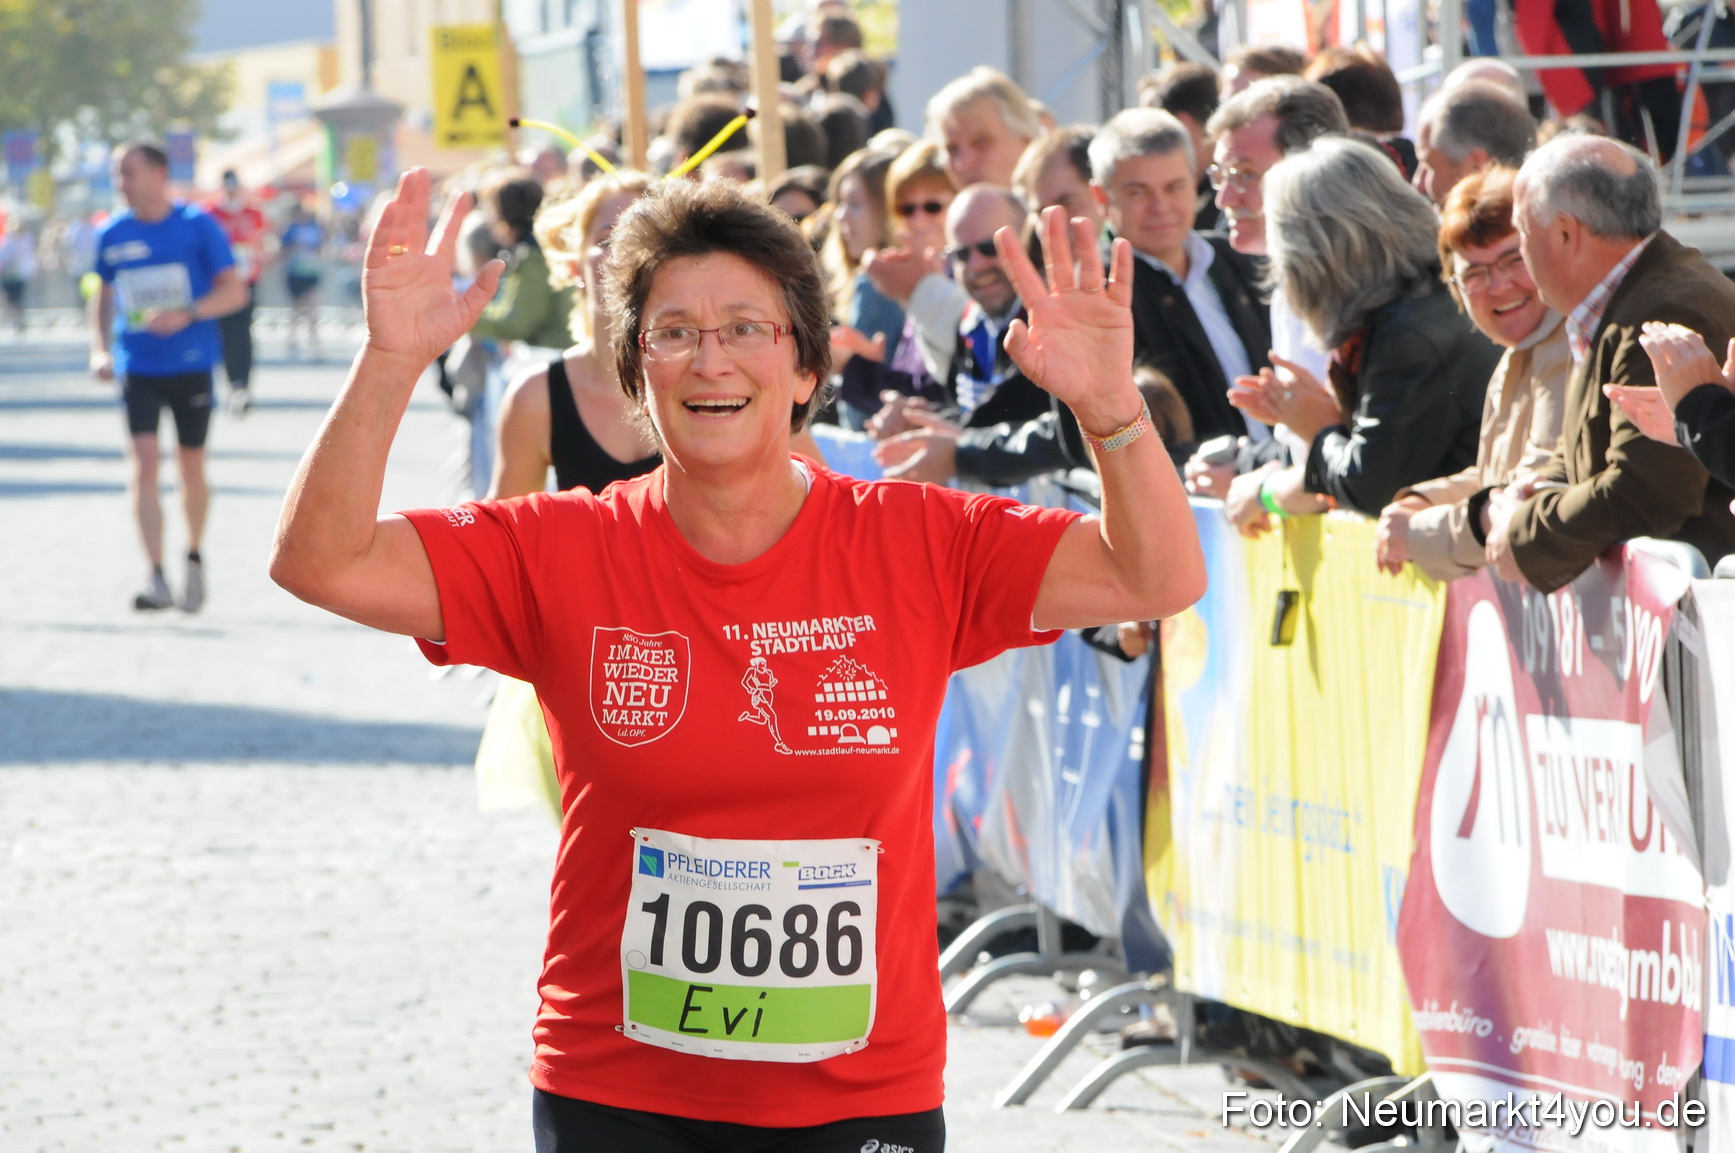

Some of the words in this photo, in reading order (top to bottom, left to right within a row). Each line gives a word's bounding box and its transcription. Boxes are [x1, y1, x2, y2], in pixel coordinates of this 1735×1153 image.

[453, 62, 495, 120] A
[722, 624, 750, 641] 11.
[753, 614, 877, 639] NEUMARKTER
[622, 632, 639, 643] 850
[639, 638, 663, 648] Jahre
[750, 632, 858, 657] STADTLAUF
[608, 644, 676, 665] IMMER
[603, 662, 679, 683] WIEDER
[602, 681, 672, 709] NEU
[602, 708, 668, 727] MARKT
[814, 707, 896, 722] 19.09.2010
[794, 746, 900, 757] www.stadtlauf-neumarkt.de
[667, 851, 771, 879] PFLEIDERER
[798, 863, 857, 881] BOCK
[667, 875, 772, 892] AKTIENGESELLSCHAFT
[641, 892, 863, 978] 10686
[678, 984, 768, 1038] Evi
